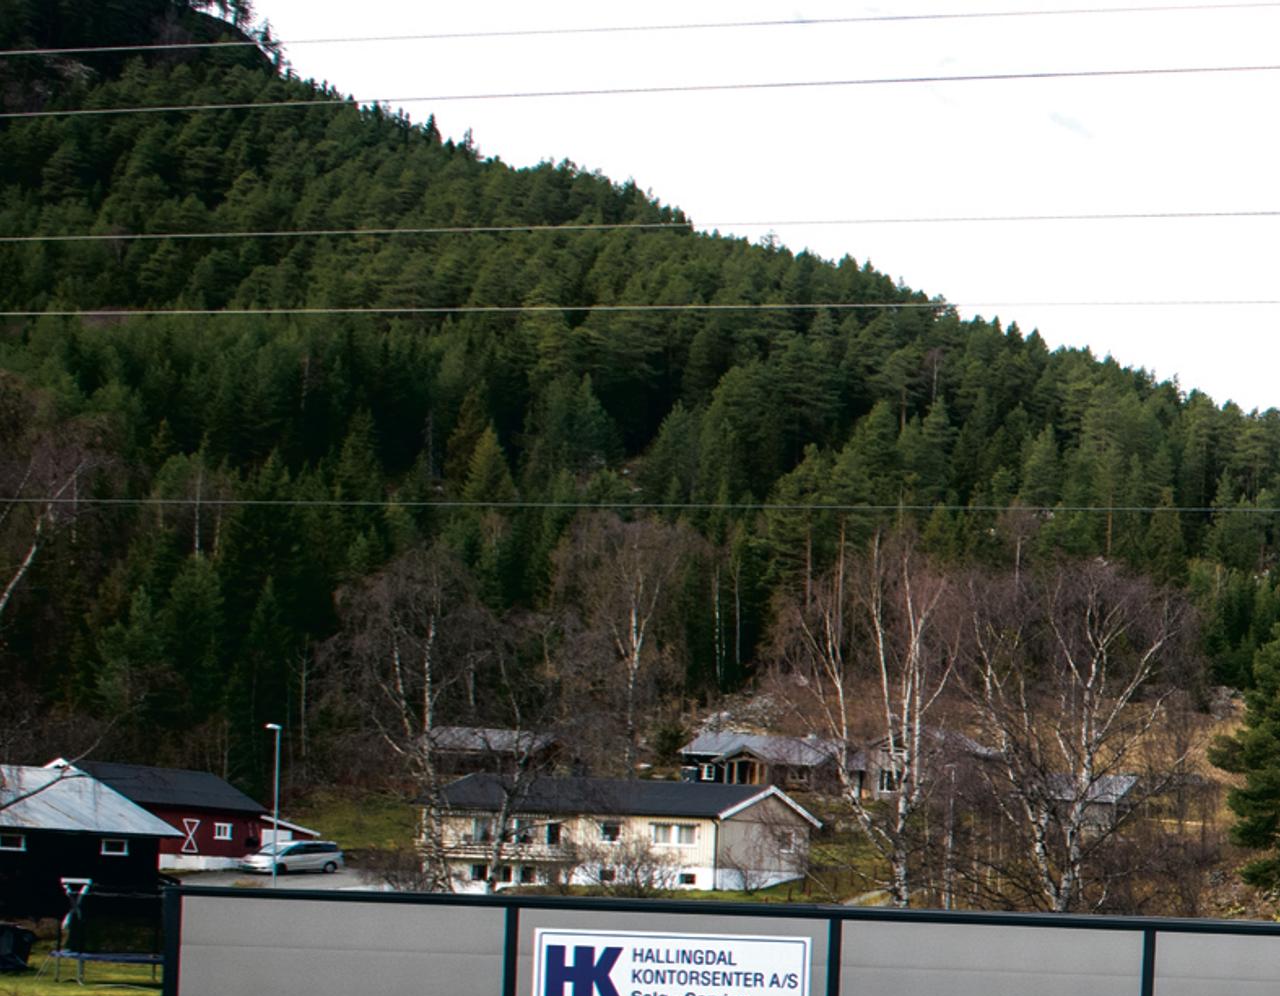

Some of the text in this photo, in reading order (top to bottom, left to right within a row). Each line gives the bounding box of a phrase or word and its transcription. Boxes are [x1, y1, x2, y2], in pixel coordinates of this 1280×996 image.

[632, 948, 737, 966] HALLINGDAL
[631, 969, 798, 989] KONTORSENTER A/S
